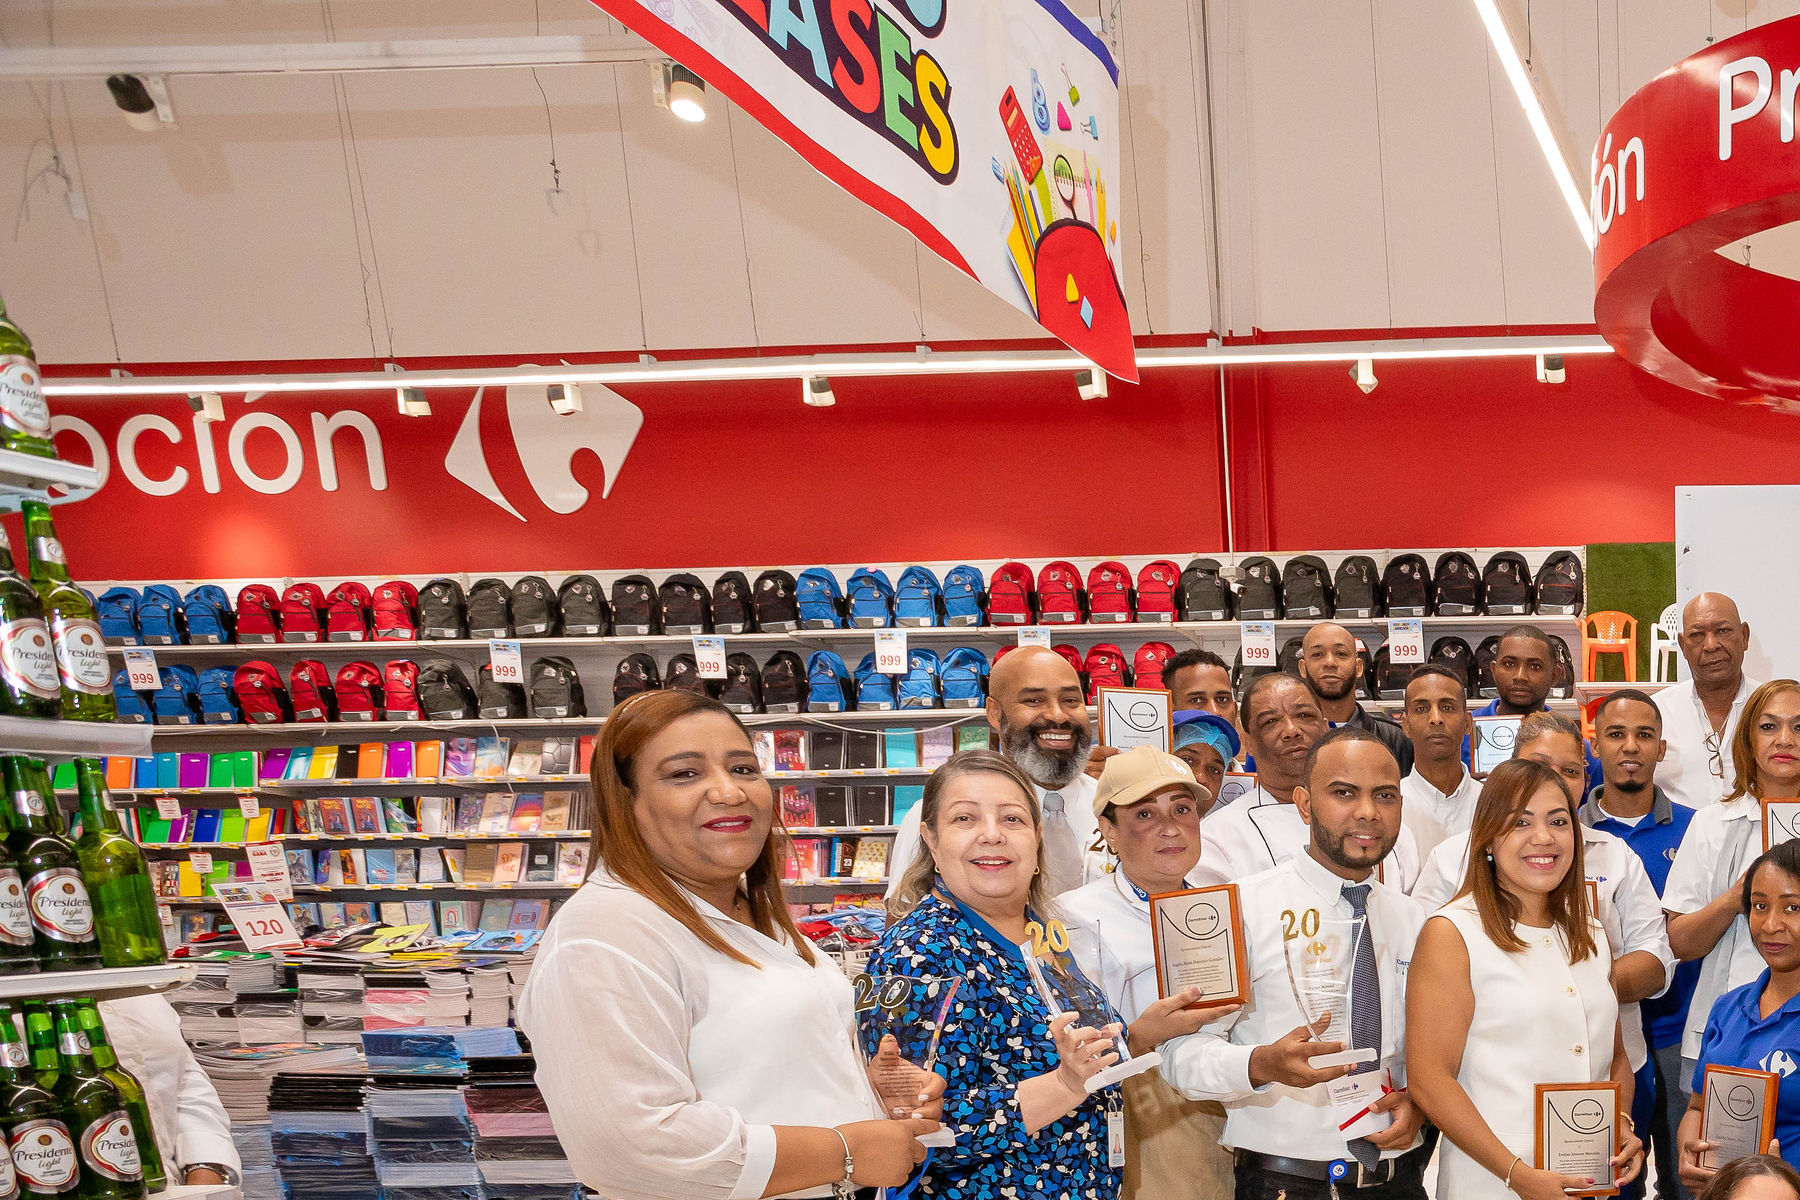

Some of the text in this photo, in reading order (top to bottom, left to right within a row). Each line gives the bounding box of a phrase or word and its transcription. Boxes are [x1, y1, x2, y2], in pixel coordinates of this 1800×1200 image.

[717, 0, 955, 175] ASES
[1246, 647, 1270, 659] 999
[1394, 644, 1418, 657] 999
[880, 654, 901, 666] 999
[495, 665, 517, 677] 999
[699, 661, 720, 673] 999
[132, 672, 154, 684] 999
[245, 919, 284, 937] 120
[1280, 908, 1320, 942] 20
[1025, 919, 1069, 957] 20
[852, 973, 912, 1012] 20
